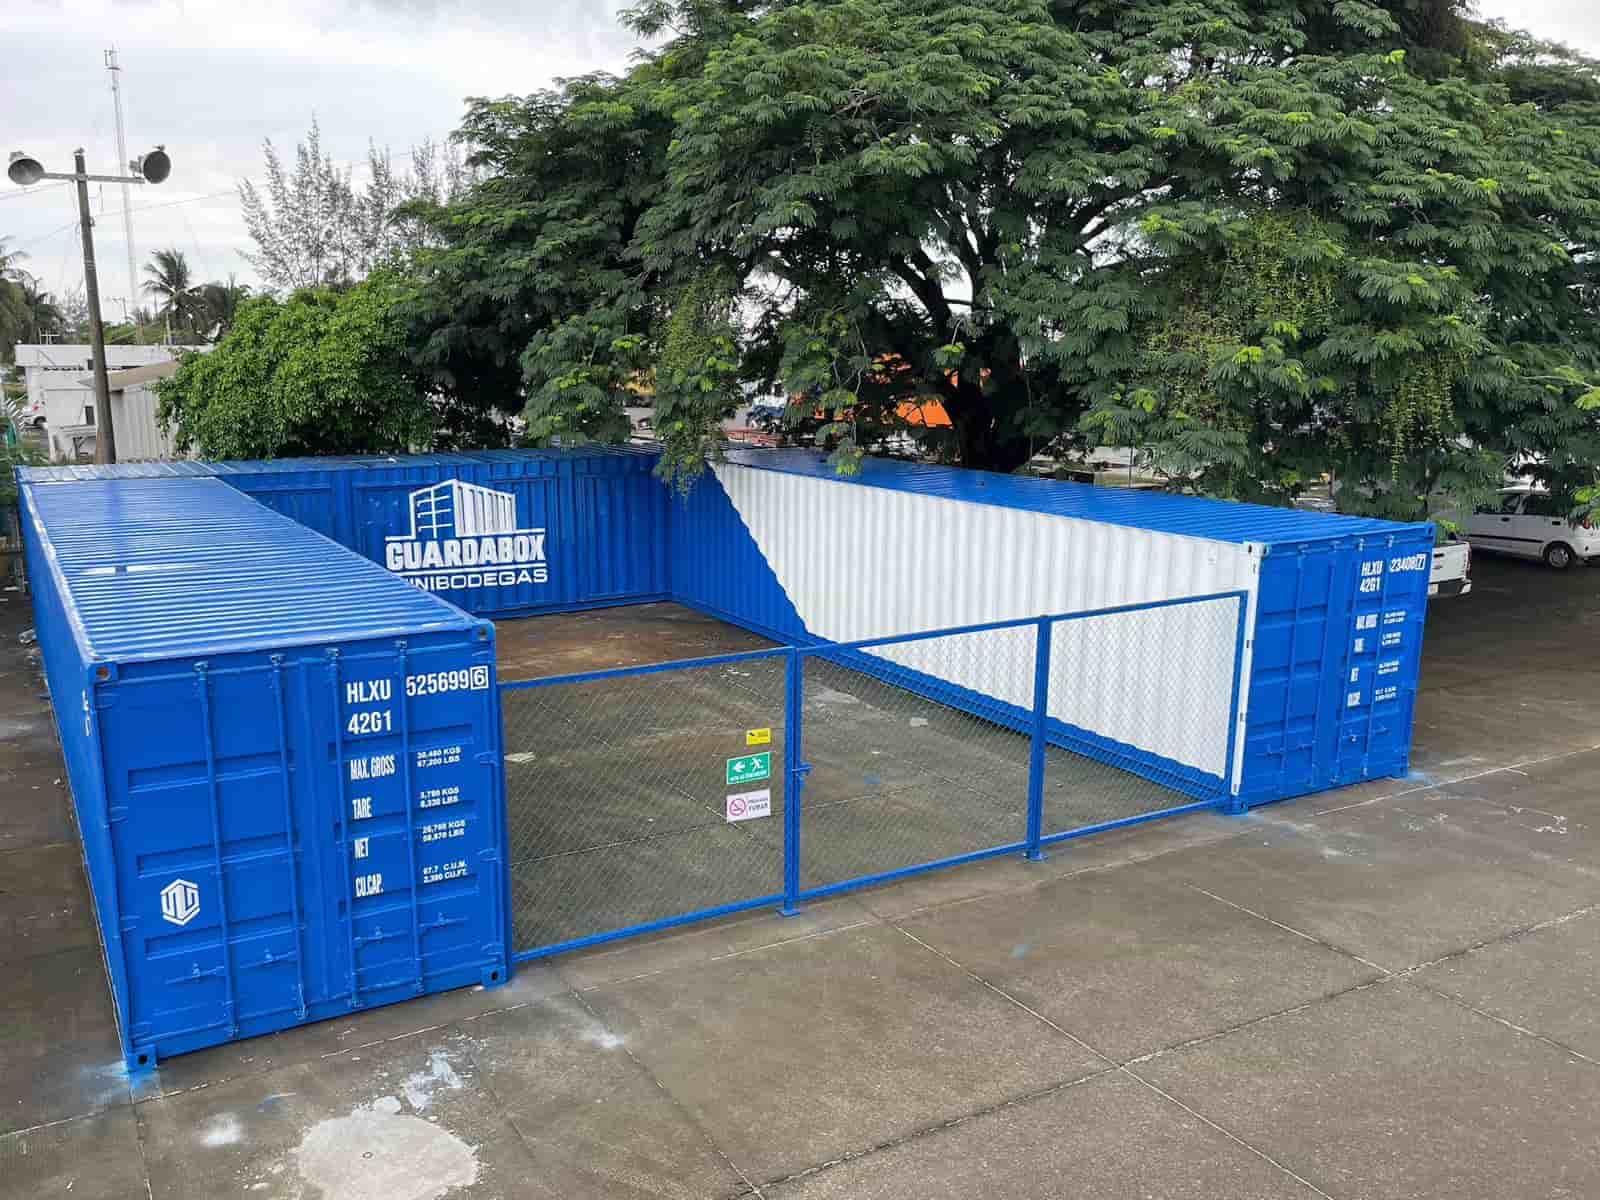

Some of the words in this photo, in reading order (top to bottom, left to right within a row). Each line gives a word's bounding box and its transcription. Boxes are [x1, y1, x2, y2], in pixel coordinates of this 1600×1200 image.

[386, 534, 546, 571] GUARDABOX
[405, 568, 548, 592] INIBODEGAS
[1361, 560, 1384, 577] HLXU
[1359, 576, 1381, 593] 42G1
[346, 679, 392, 704] HLXU
[347, 710, 392, 735] 42G1
[443, 745, 461, 756] KGS
[350, 758, 370, 781] MAX.
[370, 754, 396, 778] GROSS
[352, 797, 372, 820] TARE
